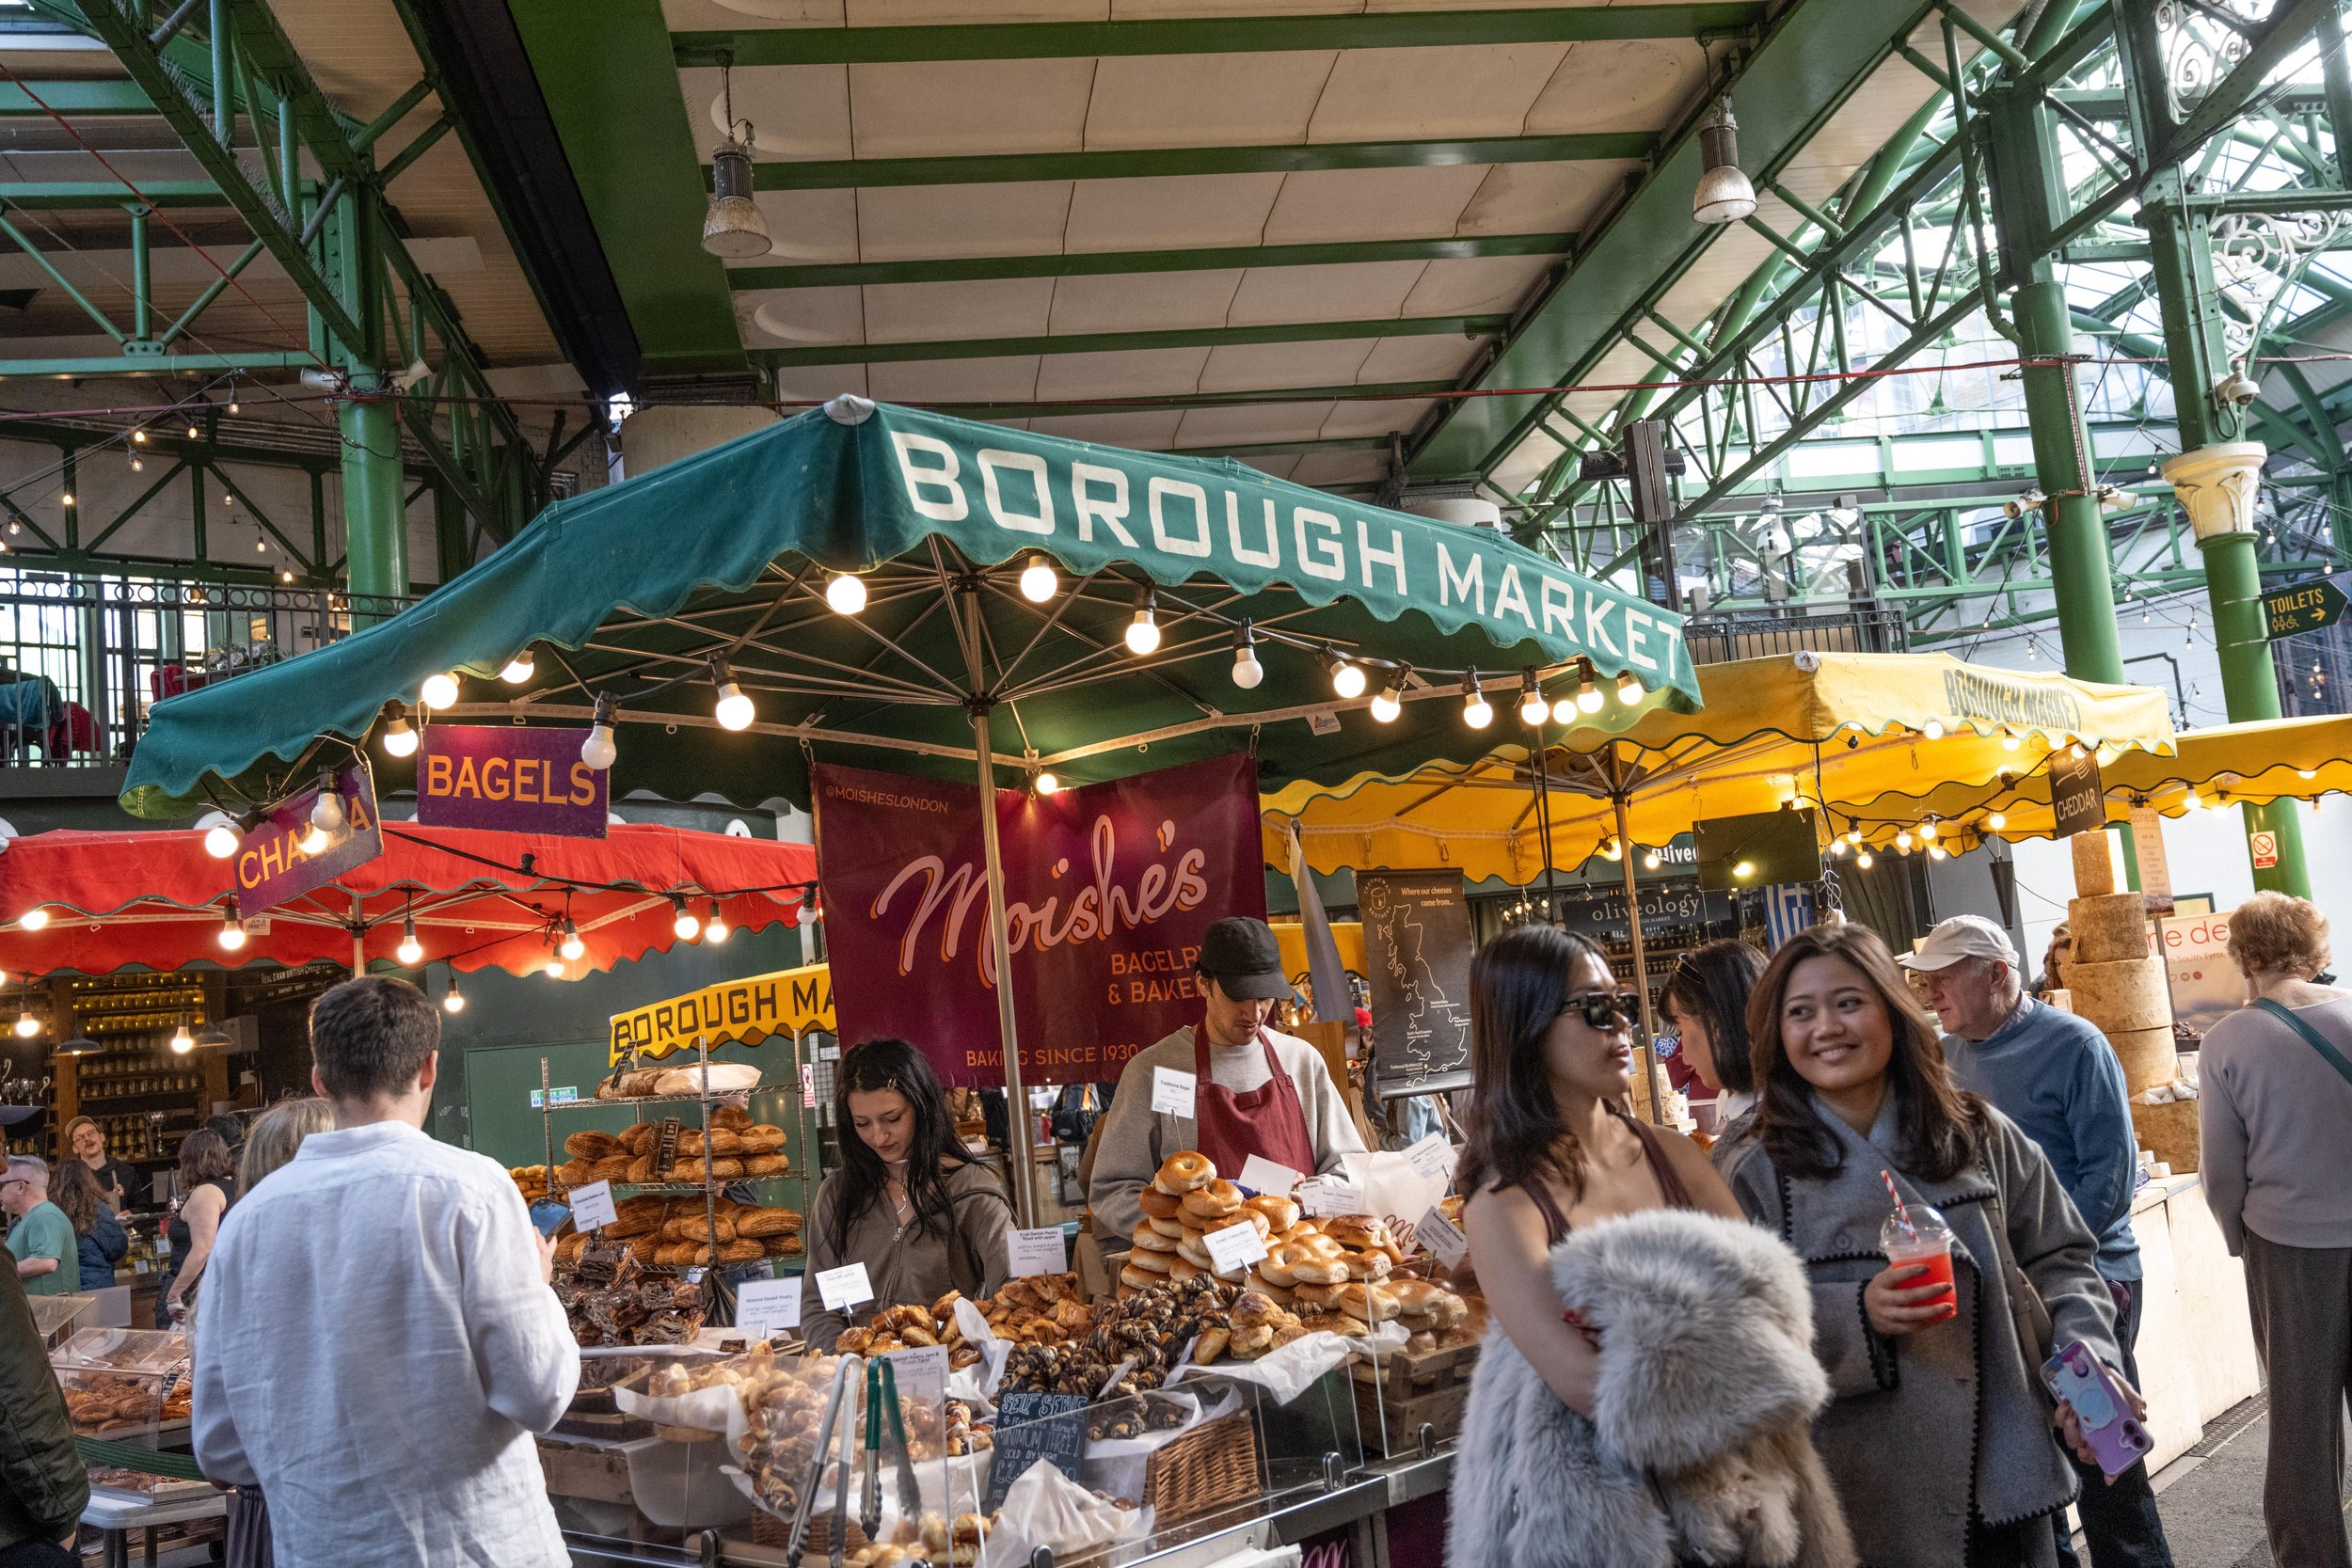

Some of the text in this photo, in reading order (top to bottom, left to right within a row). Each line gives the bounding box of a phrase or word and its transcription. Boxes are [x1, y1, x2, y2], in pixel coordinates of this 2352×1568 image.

[891, 431, 1681, 680] BOROUGH MARKET
[2268, 588, 2325, 615] TOILETS
[1943, 670, 2023, 723] BOROUGH
[427, 754, 596, 807] BAGELS
[826, 784, 948, 814] @MOISHESLONDON
[2057, 787, 2098, 821] CHEDDAR
[1401, 887, 1421, 896] Where
[1431, 886, 1453, 895] cheeses
[1421, 899, 1436, 908] come
[2177, 955, 2202, 964] South
[1108, 983, 1121, 1006] &
[614, 983, 777, 1053] BOROUGH
[966, 1049, 1028, 1068] BAKIG
[1036, 1047, 1096, 1066] SINCE
[1002, 1392, 1089, 1423] SELF SERVE
[996, 1428, 1041, 1450] MINIMUM
[1004, 1449, 1022, 1460] SOLD
[1025, 1449, 1036, 1461] BY
